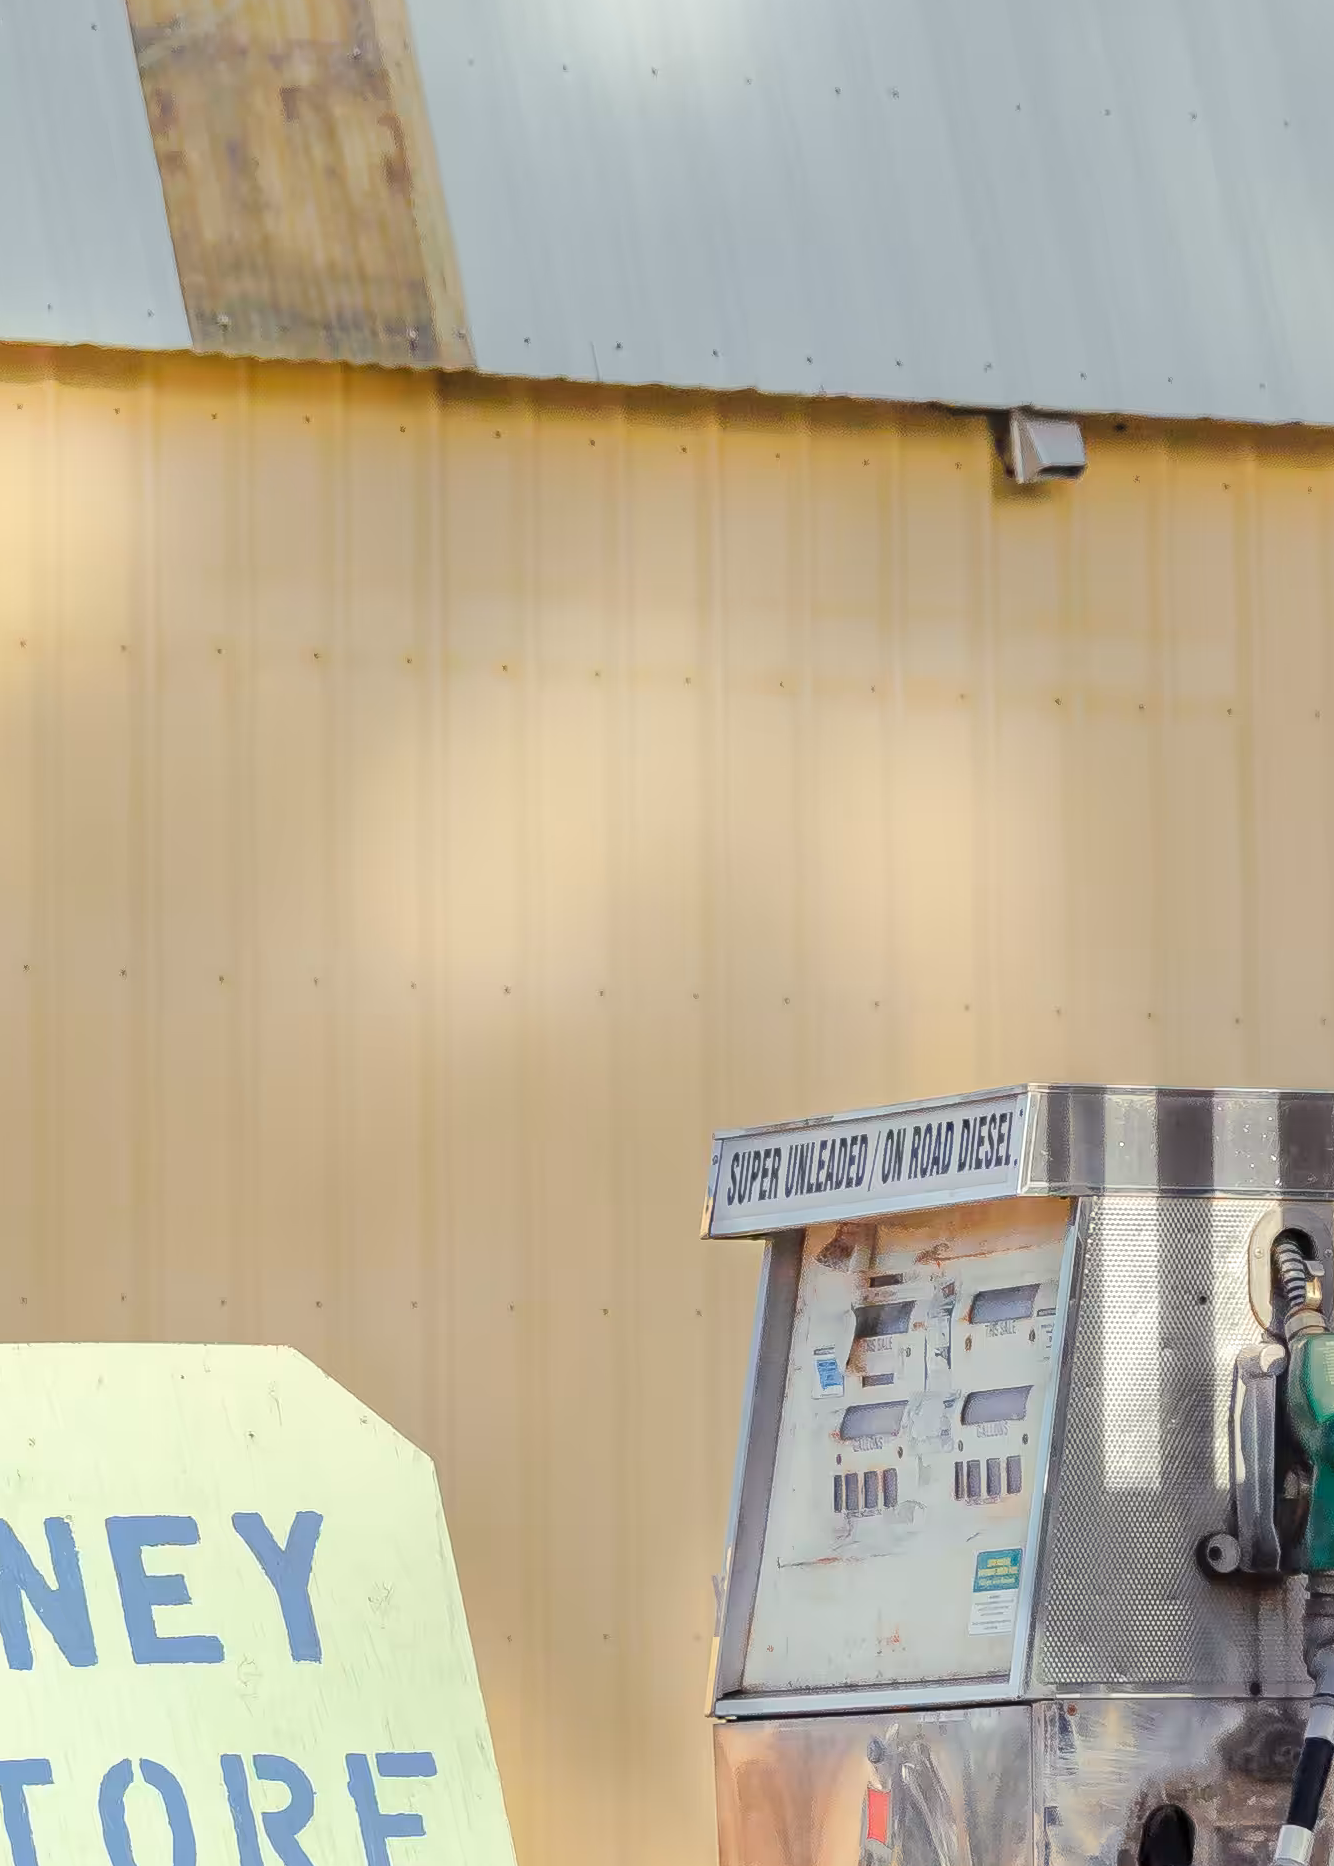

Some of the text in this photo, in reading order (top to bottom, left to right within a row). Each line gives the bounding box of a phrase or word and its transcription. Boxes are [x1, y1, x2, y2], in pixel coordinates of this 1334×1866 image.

[727, 1147, 782, 1206] SUPER
[784, 1133, 869, 1198] UNLEADED
[881, 1128, 906, 1184] ON
[908, 1121, 955, 1180] ROAD
[957, 1112, 1014, 1173] DIESEL
